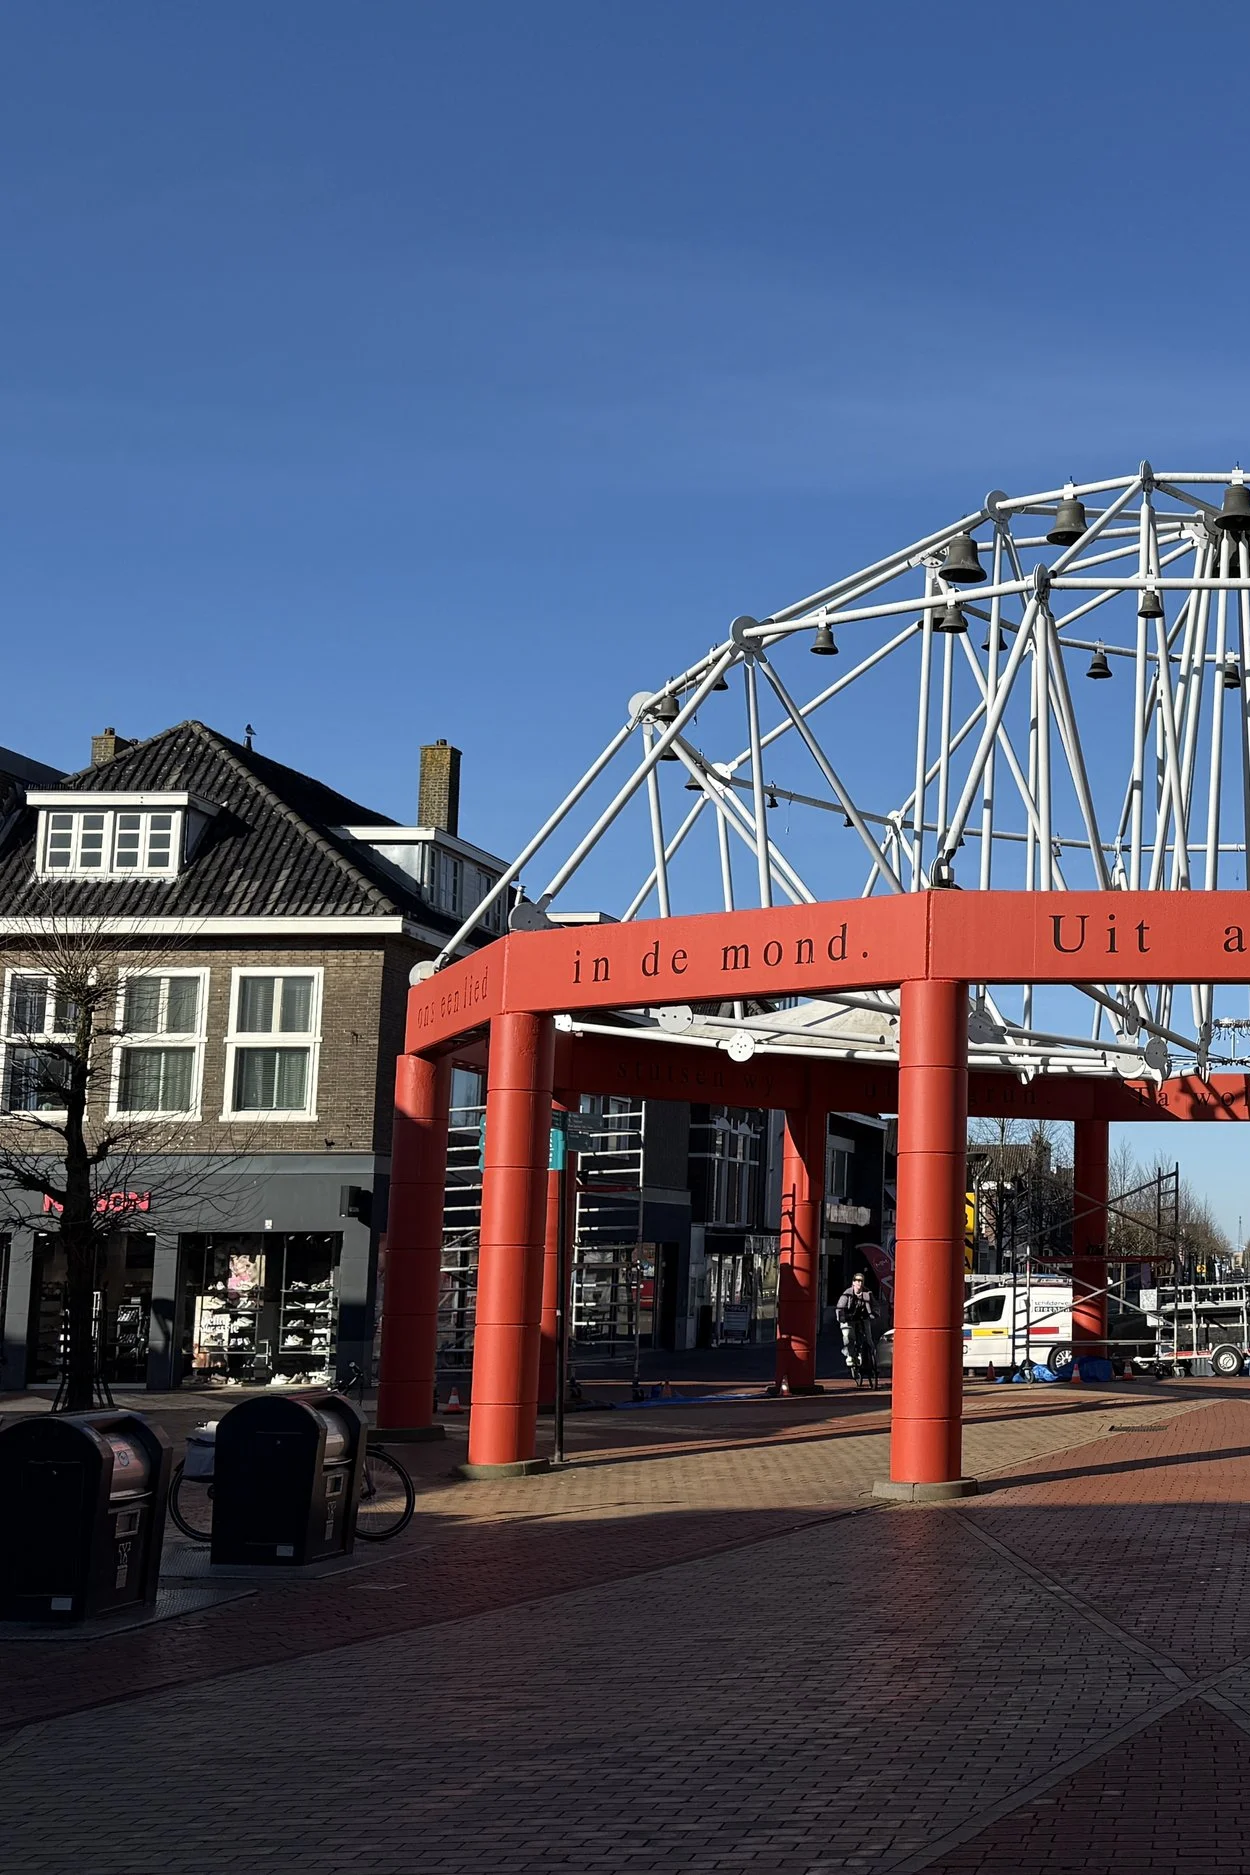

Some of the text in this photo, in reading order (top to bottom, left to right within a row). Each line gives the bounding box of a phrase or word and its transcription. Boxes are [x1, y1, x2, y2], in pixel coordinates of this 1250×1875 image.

[572, 922, 869, 984] in de mond.
[1048, 913, 1151, 953] Uit
[416, 966, 489, 1029] ons een lied
